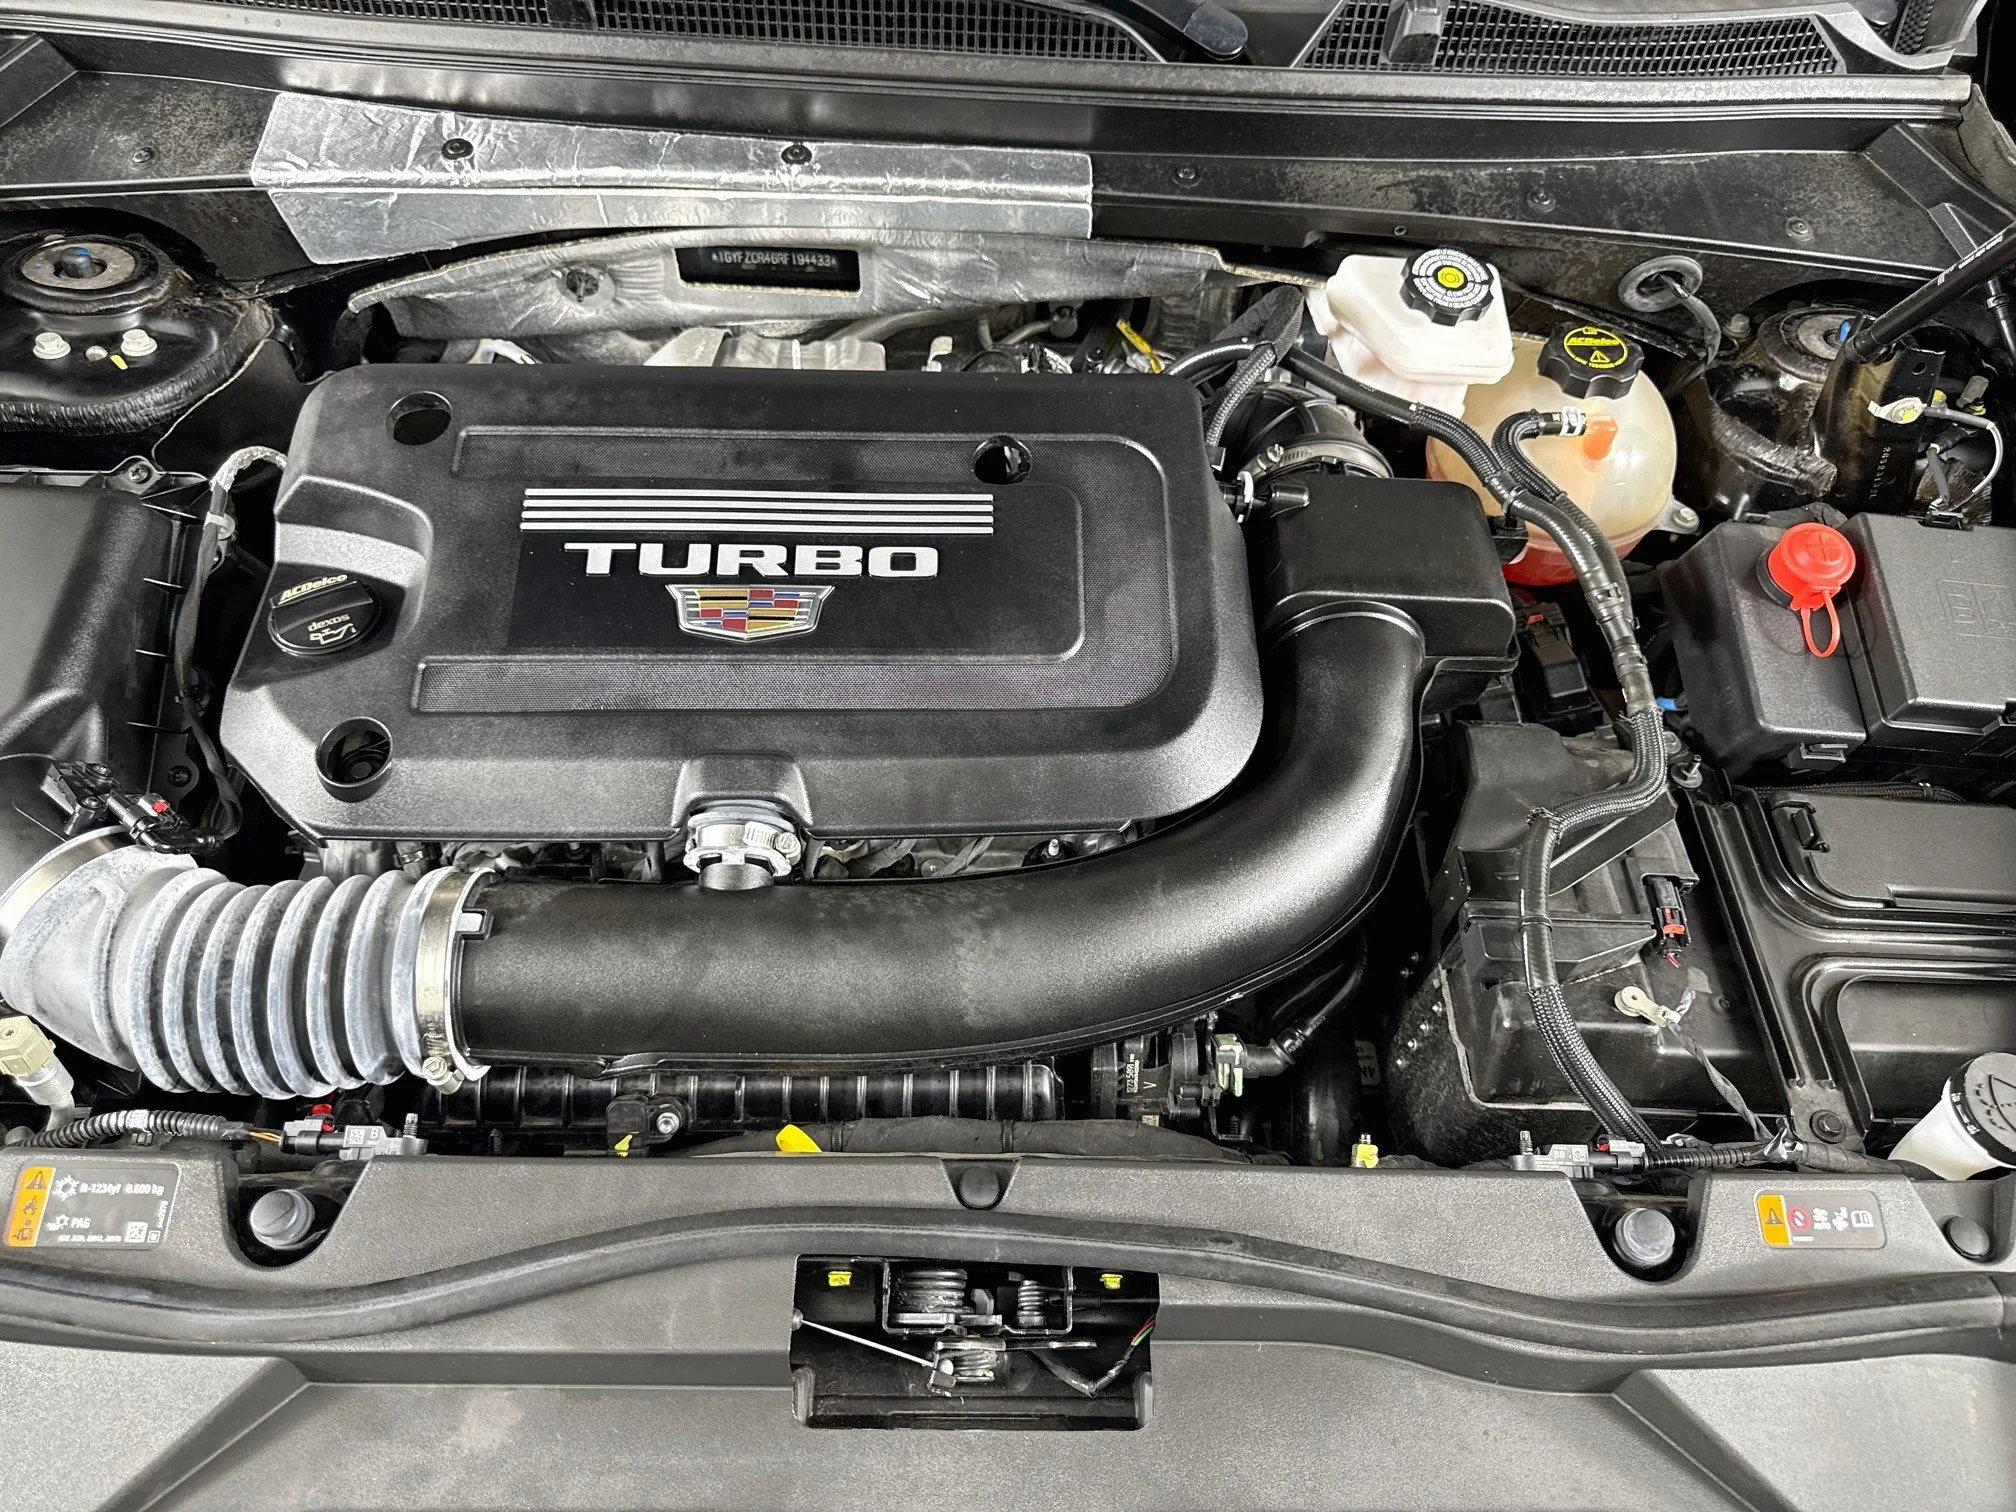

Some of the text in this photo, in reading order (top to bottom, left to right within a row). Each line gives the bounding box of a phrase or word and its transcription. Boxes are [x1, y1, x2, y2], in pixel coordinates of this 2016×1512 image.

[564, 542, 939, 577] TURBO
[280, 574, 348, 601] ACDelco
[308, 614, 351, 632] dexos
[152, 1184, 164, 1196] kg
[71, 1218, 91, 1229] PAG
